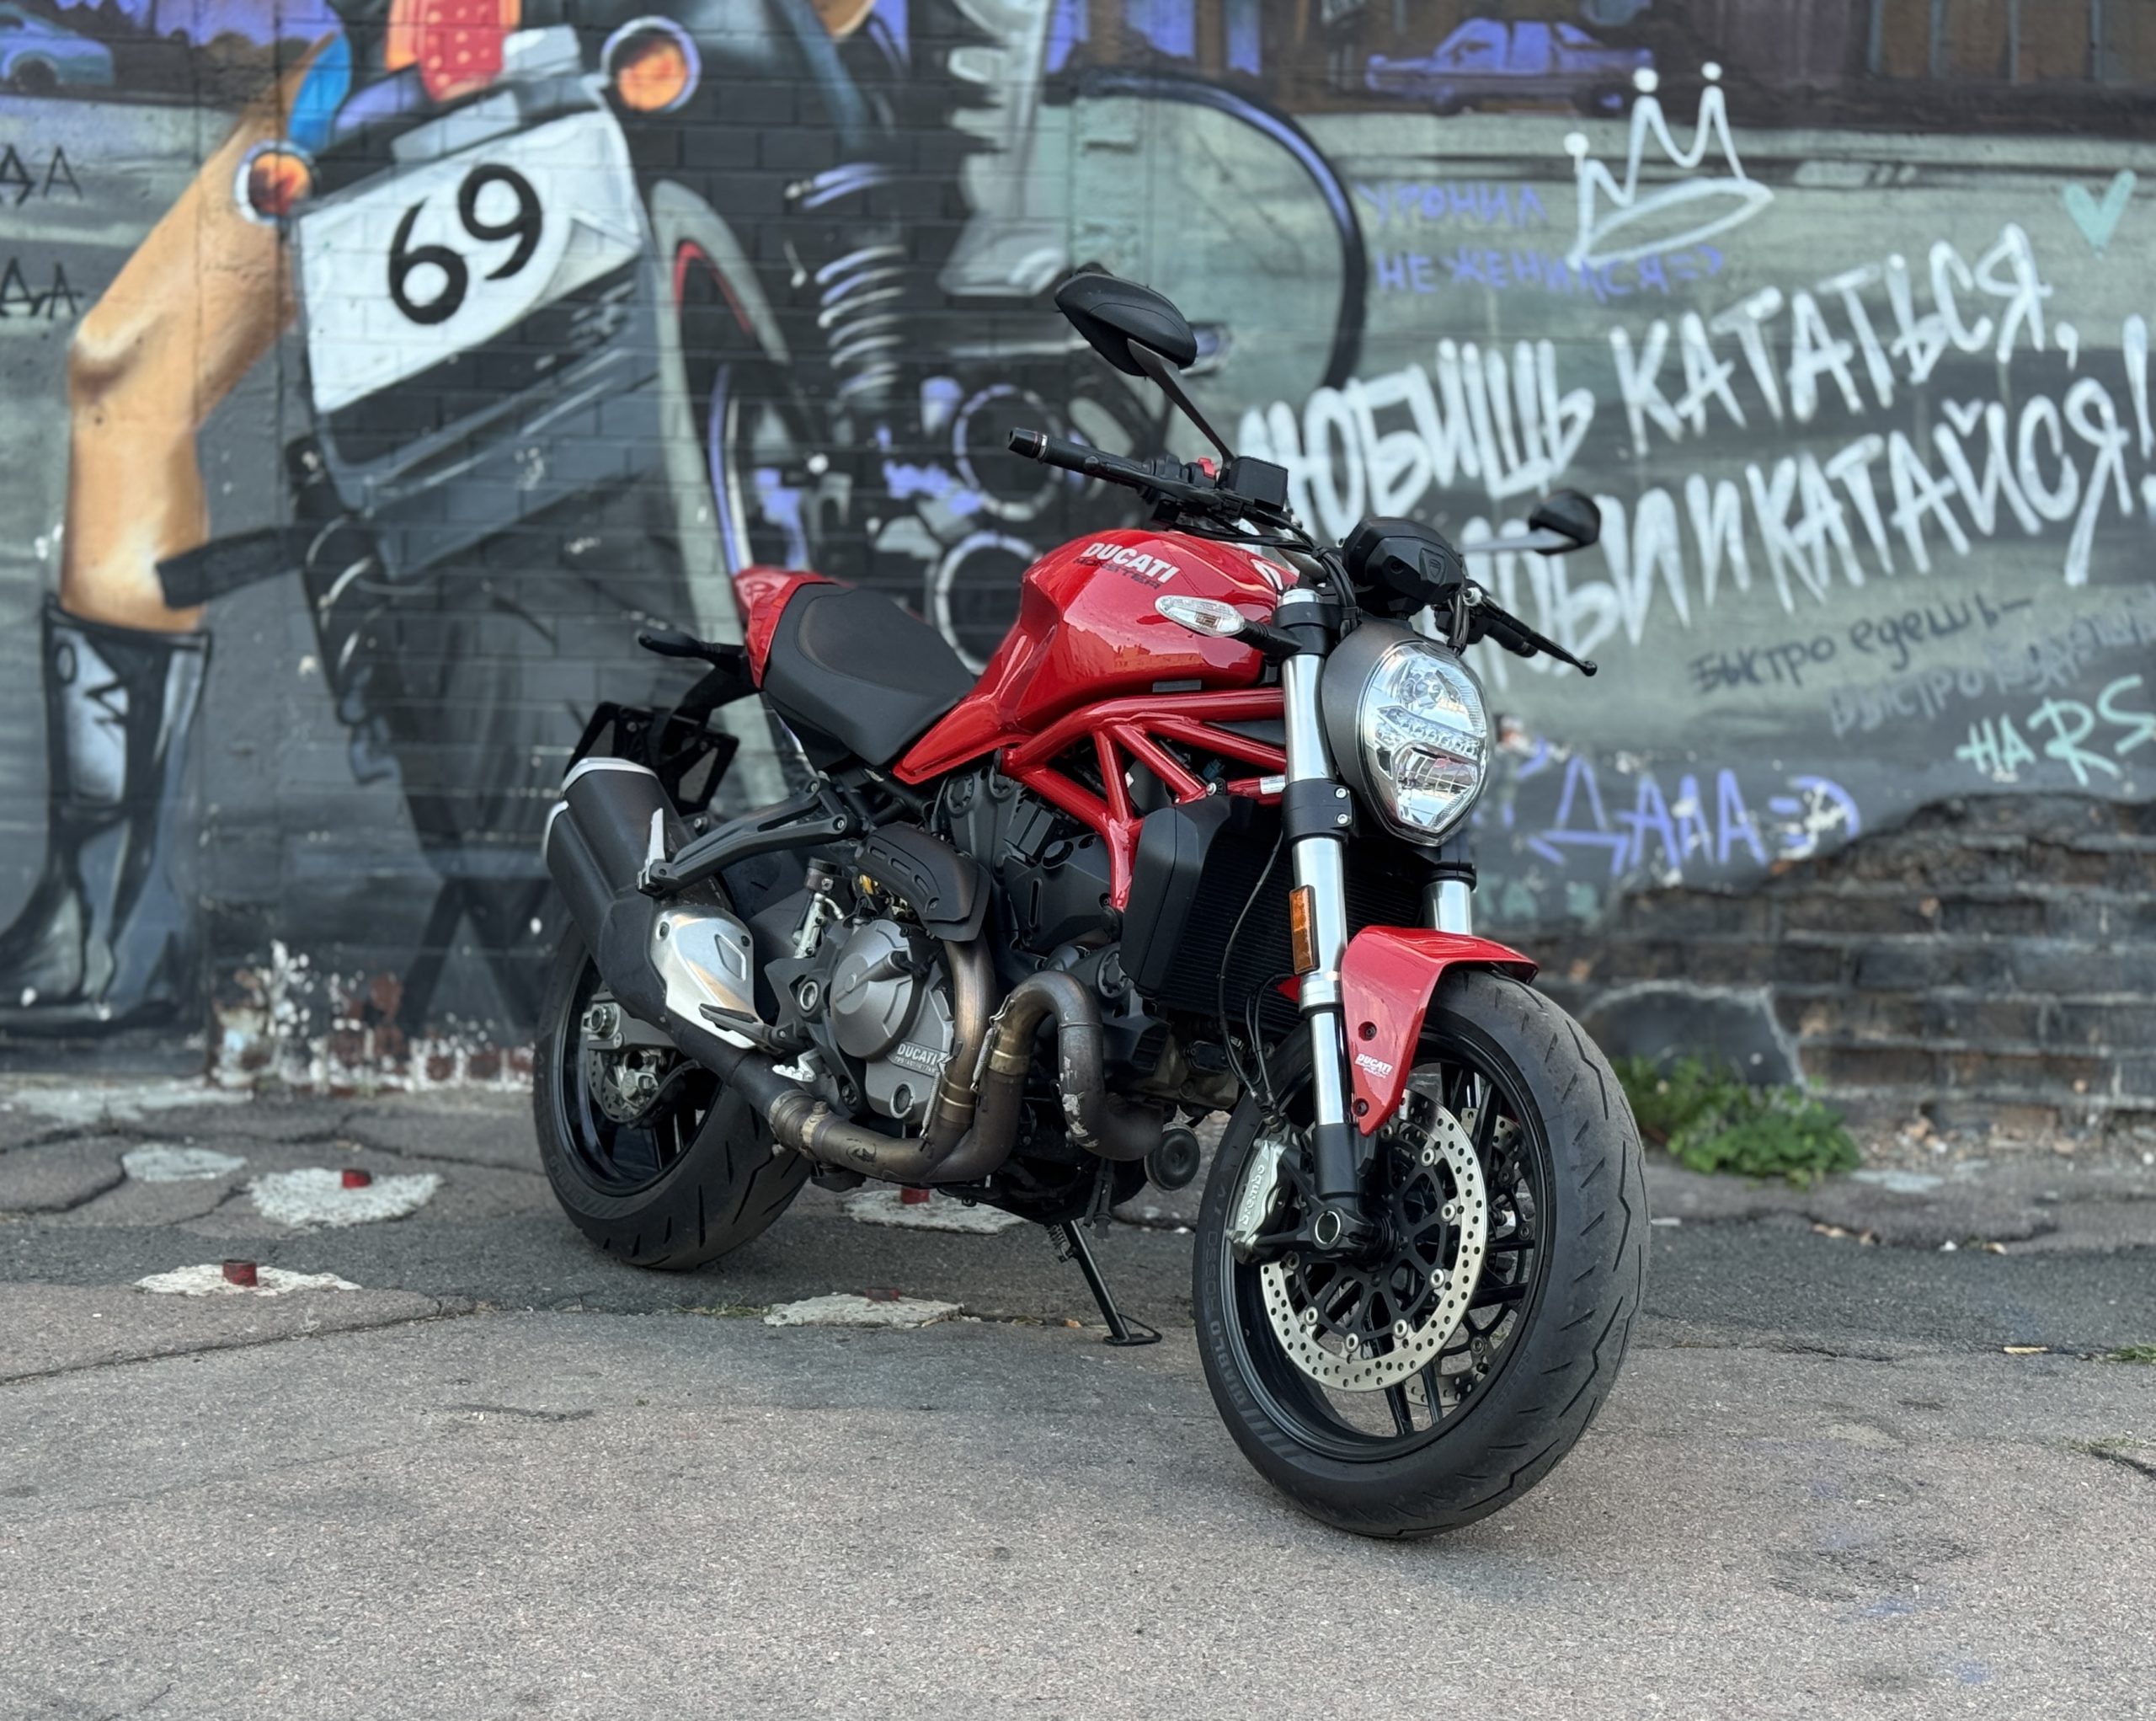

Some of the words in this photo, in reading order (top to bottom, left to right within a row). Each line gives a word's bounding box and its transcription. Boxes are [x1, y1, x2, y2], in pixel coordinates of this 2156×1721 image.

[388, 163, 543, 325] 69
[1375, 249, 1436, 293] НЕ
[1073, 557, 1161, 590] MONSTER
[1081, 542, 1181, 584] DUCATI
[896, 1043, 938, 1066] DUCATI
[1354, 1053, 1394, 1074] DUCATI
[1239, 1164, 1265, 1227] brembo
[1209, 1320, 1247, 1406] DIABLO
